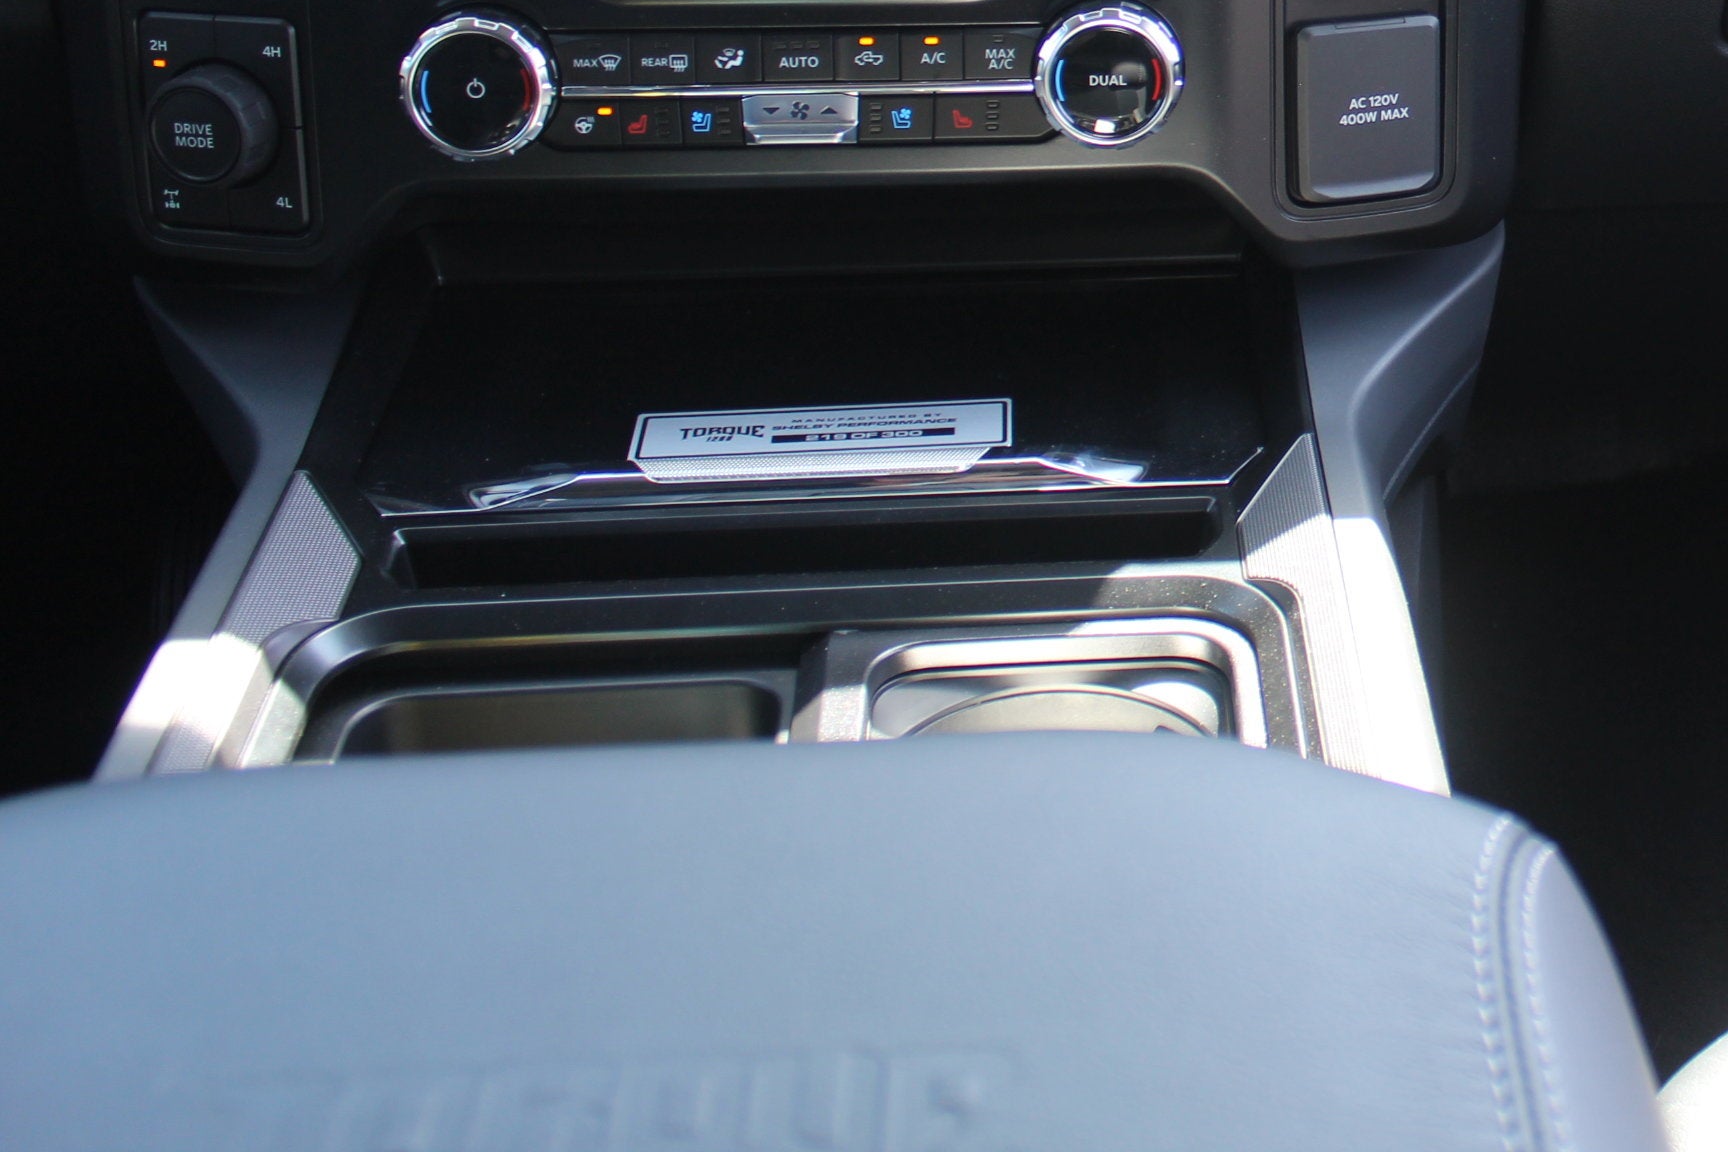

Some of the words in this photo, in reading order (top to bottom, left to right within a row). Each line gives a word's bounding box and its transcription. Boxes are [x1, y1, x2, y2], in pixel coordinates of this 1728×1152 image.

[149, 39, 168, 52] 2H
[262, 45, 281, 58] 4H
[920, 52, 946, 65] A/C
[984, 48, 1016, 60] MAX
[573, 57, 598, 68] MAX
[641, 56, 668, 68] REAR
[779, 56, 819, 68] AUTO
[988, 58, 1014, 71] A/C
[1088, 74, 1127, 87] DUAL
[1348, 96, 1367, 110] AC
[1368, 93, 1399, 109] 120V
[1338, 111, 1377, 127] 400W
[1380, 107, 1409, 122] MAX
[173, 122, 213, 136] DRIVE
[174, 136, 214, 149] MODE
[275, 196, 293, 208] 4L
[791, 414, 917, 424] MANUFACTURED
[836, 418, 958, 428] PERFORMANCE
[680, 425, 766, 440] TORQUE
